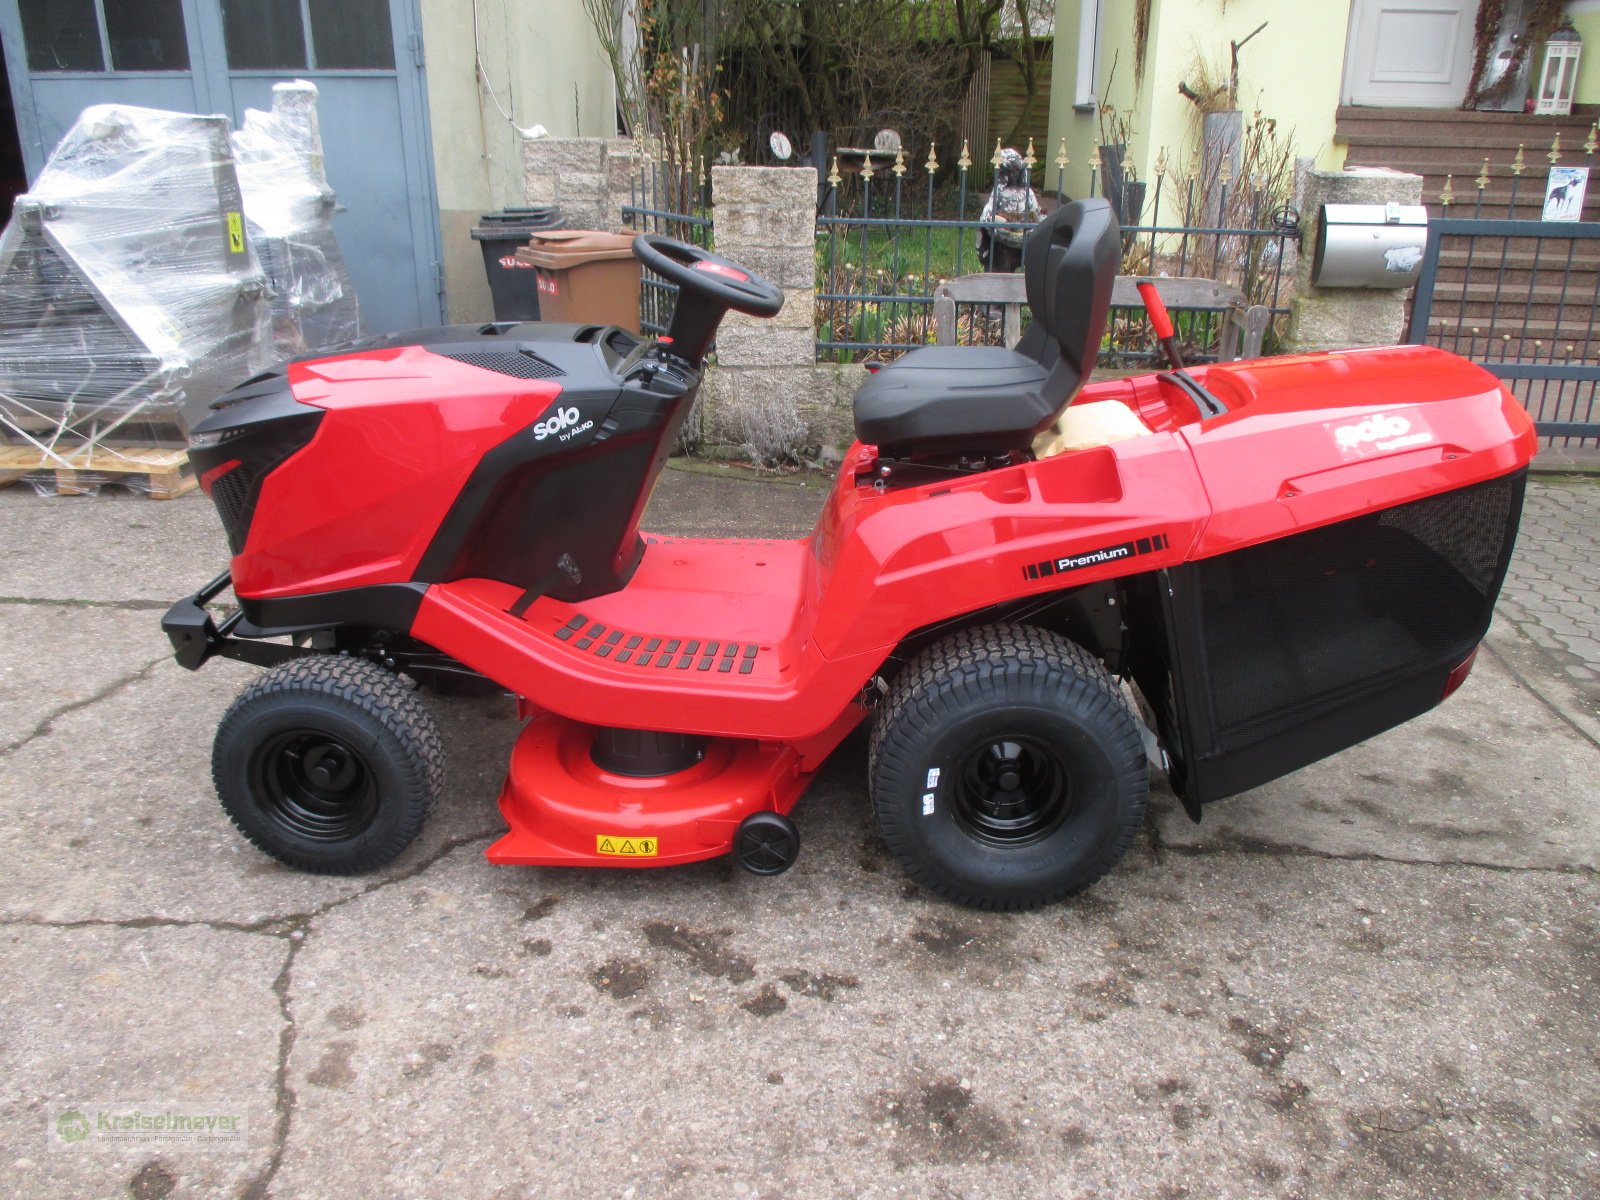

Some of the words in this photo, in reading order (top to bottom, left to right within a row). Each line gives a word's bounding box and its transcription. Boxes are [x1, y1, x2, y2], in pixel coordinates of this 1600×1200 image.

[533, 407, 580, 441] solo
[559, 432, 571, 441] by
[1058, 547, 1128, 570] Premium
